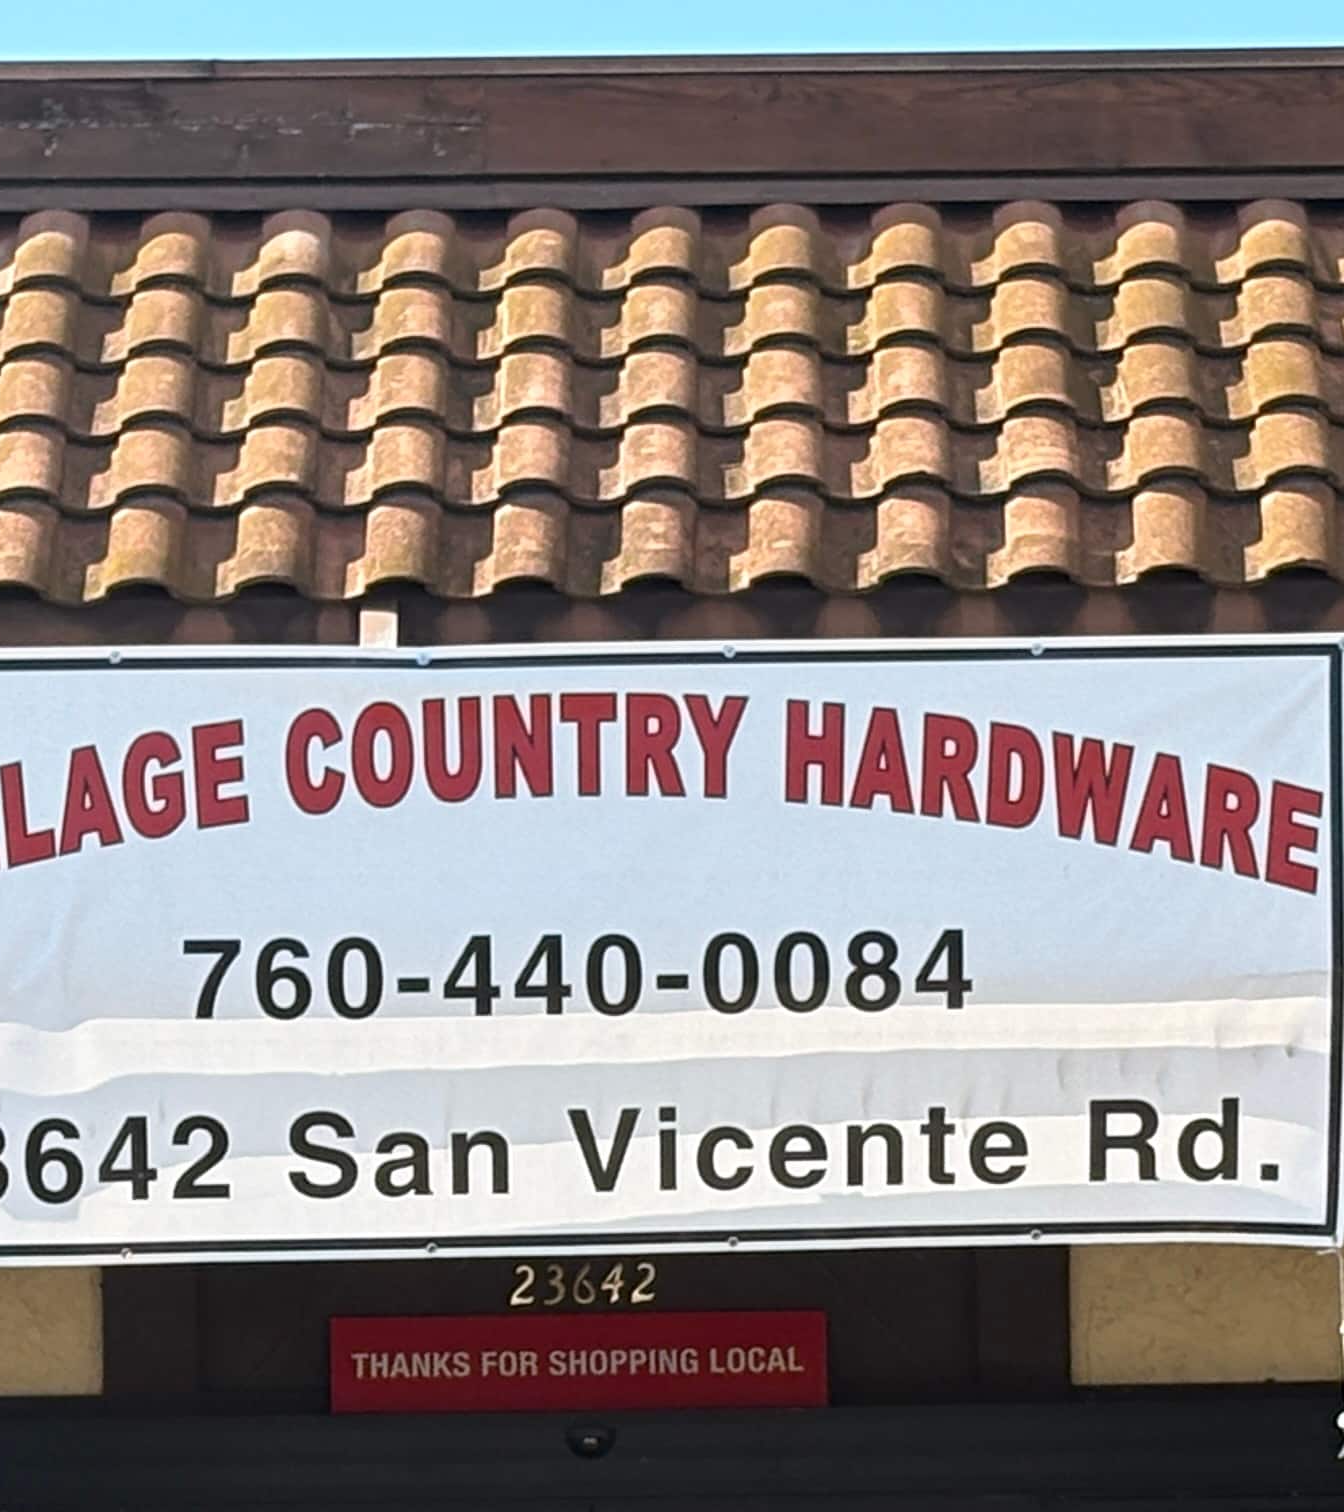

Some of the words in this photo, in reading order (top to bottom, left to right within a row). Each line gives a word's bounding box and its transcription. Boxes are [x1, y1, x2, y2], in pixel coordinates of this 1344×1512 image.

[286, 692, 749, 815] COUNTRY
[783, 699, 1325, 895] HARDWARE
[181, 929, 973, 1020] 760-440-0084
[287, 1109, 510, 1198] San
[568, 1100, 1030, 1196] Vicente
[1086, 1098, 1281, 1189] Rd.
[510, 1262, 656, 1306] 23642
[352, 1352, 470, 1379] THANKS
[482, 1351, 537, 1377] FOR
[549, 1348, 698, 1376] SHOPPING
[709, 1346, 803, 1373] LOCAL
